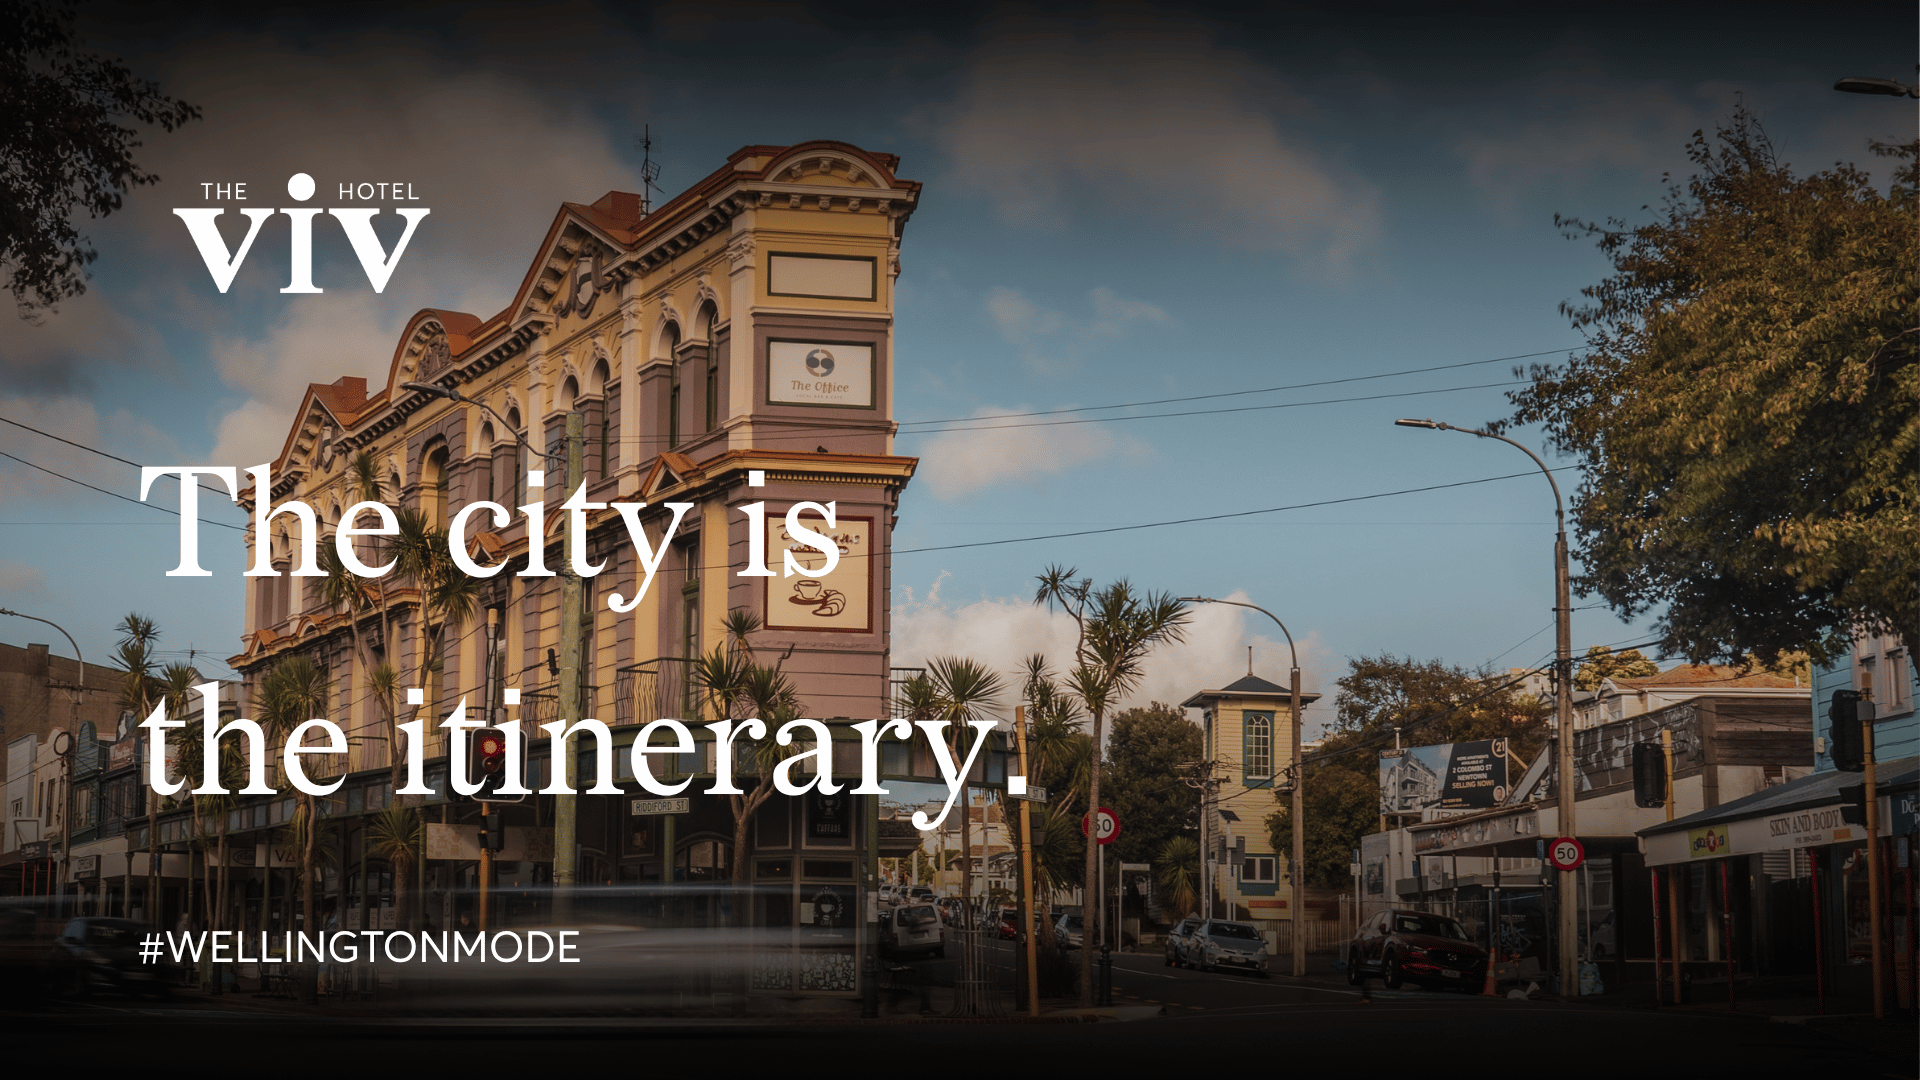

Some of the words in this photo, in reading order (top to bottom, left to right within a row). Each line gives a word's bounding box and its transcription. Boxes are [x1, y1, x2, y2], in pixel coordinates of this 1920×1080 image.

[791, 380, 811, 391] The
[814, 381, 849, 394] Office
[1496, 741, 1505, 752] 21
[1457, 764, 1485, 773] COLOMBO
[1457, 773, 1487, 781] NEWTOWN
[1452, 781, 1476, 789] SELLING
[1477, 779, 1494, 787] NOW!
[635, 801, 672, 813] RIDDIFORD
[676, 800, 685, 811] ST
[1769, 817, 1791, 836] SKIN
[1792, 814, 1812, 833] AND
[1812, 809, 1839, 831] BODY
[1557, 847, 1576, 860] 50
